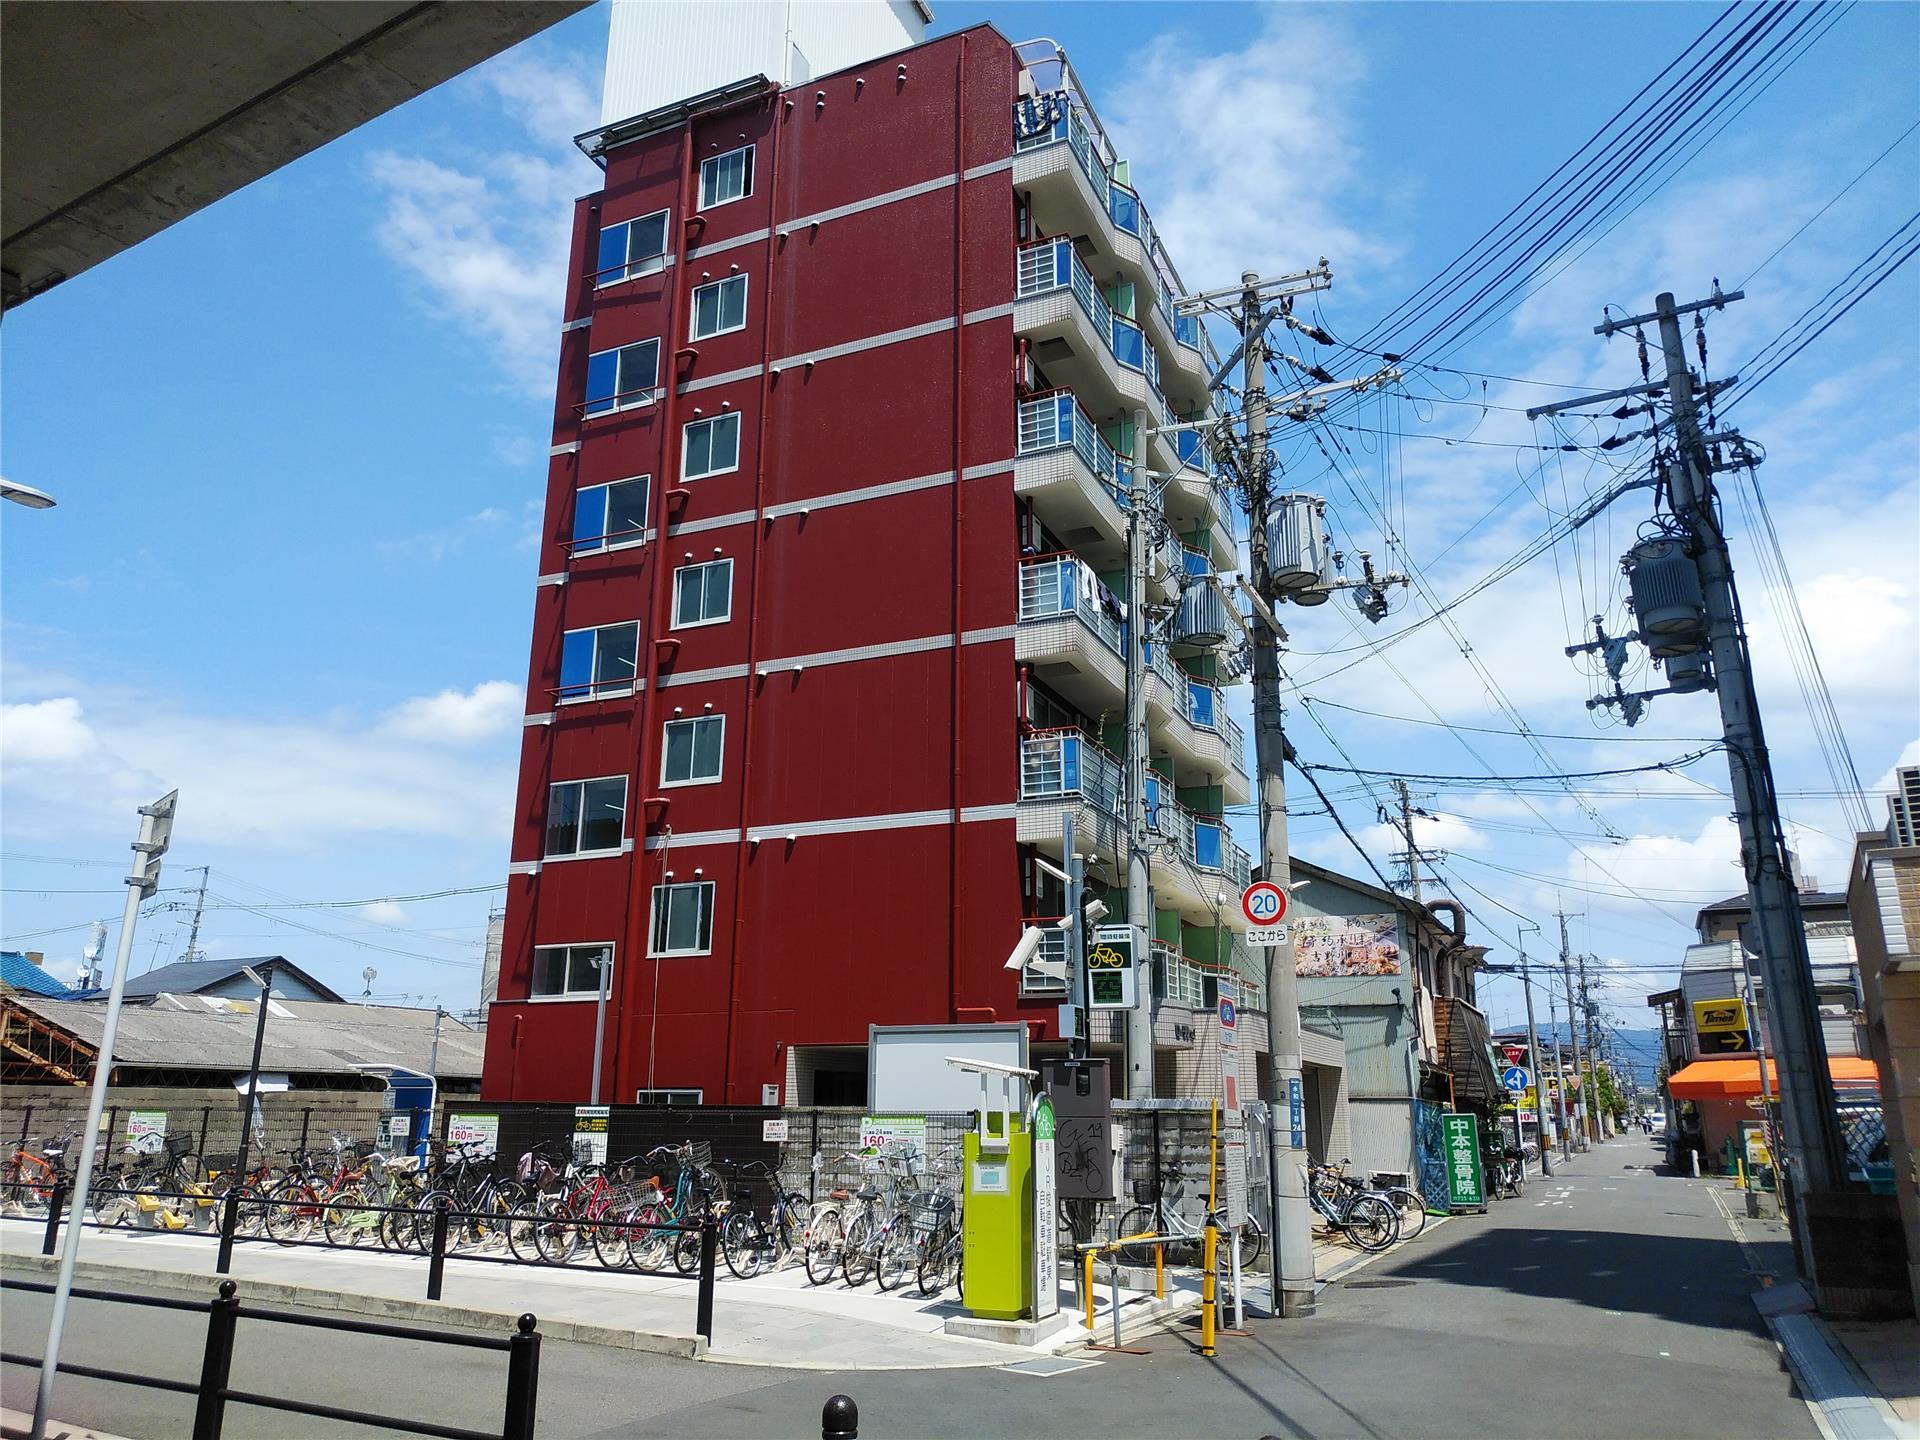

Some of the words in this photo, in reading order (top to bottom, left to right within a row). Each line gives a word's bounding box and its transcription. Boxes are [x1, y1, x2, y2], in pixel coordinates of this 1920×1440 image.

[1252, 895, 1277, 913] 20
[1248, 930, 1286, 942] ここから
[1312, 949, 1348, 962] 吉野川
[1703, 1008, 1737, 1024] Times
[450, 1131, 473, 1141] 160円
[1450, 1118, 1476, 1195] 中本整骨院
